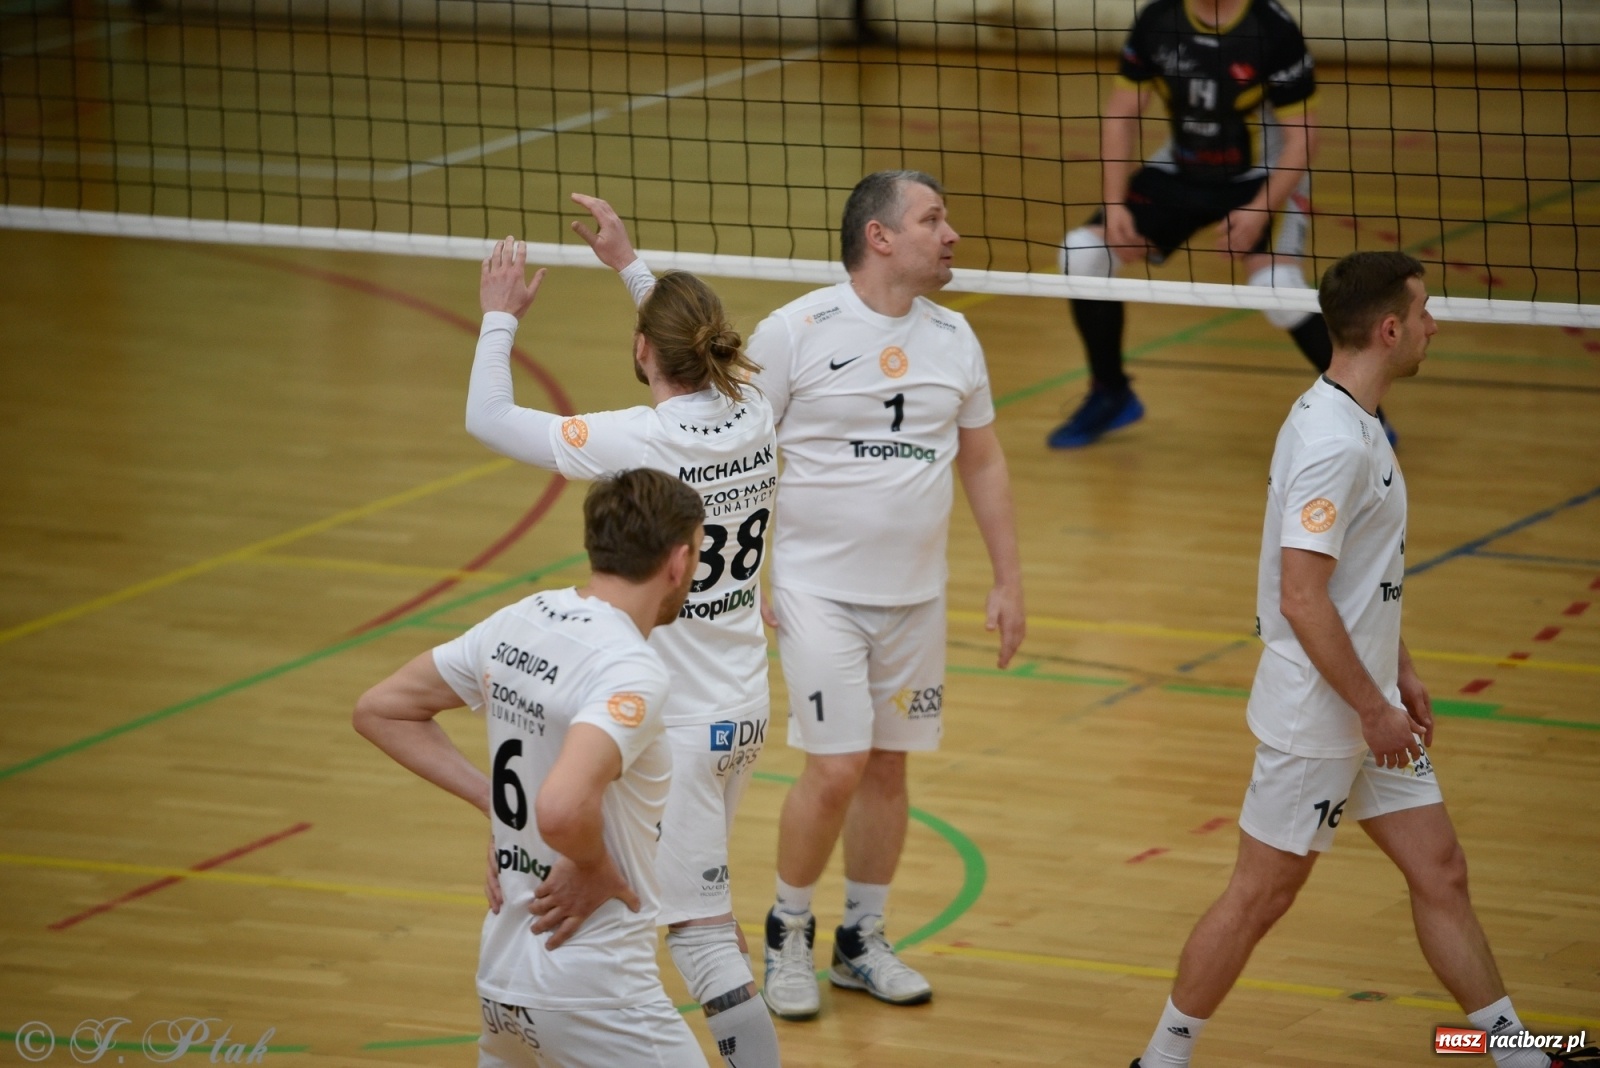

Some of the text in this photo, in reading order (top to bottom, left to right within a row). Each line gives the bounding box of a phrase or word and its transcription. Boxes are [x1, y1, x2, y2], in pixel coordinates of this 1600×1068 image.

[884, 393, 904, 432] 1
[679, 443, 774, 484] MICHALAK
[849, 440, 936, 463] TropiDog
[703, 476, 776, 507] ZOO-MAR
[491, 641, 559, 686] SKORUPA
[808, 690, 824, 722] 1
[739, 718, 767, 747] DK
[492, 738, 528, 831] 6
[1314, 797, 1347, 830] 16
